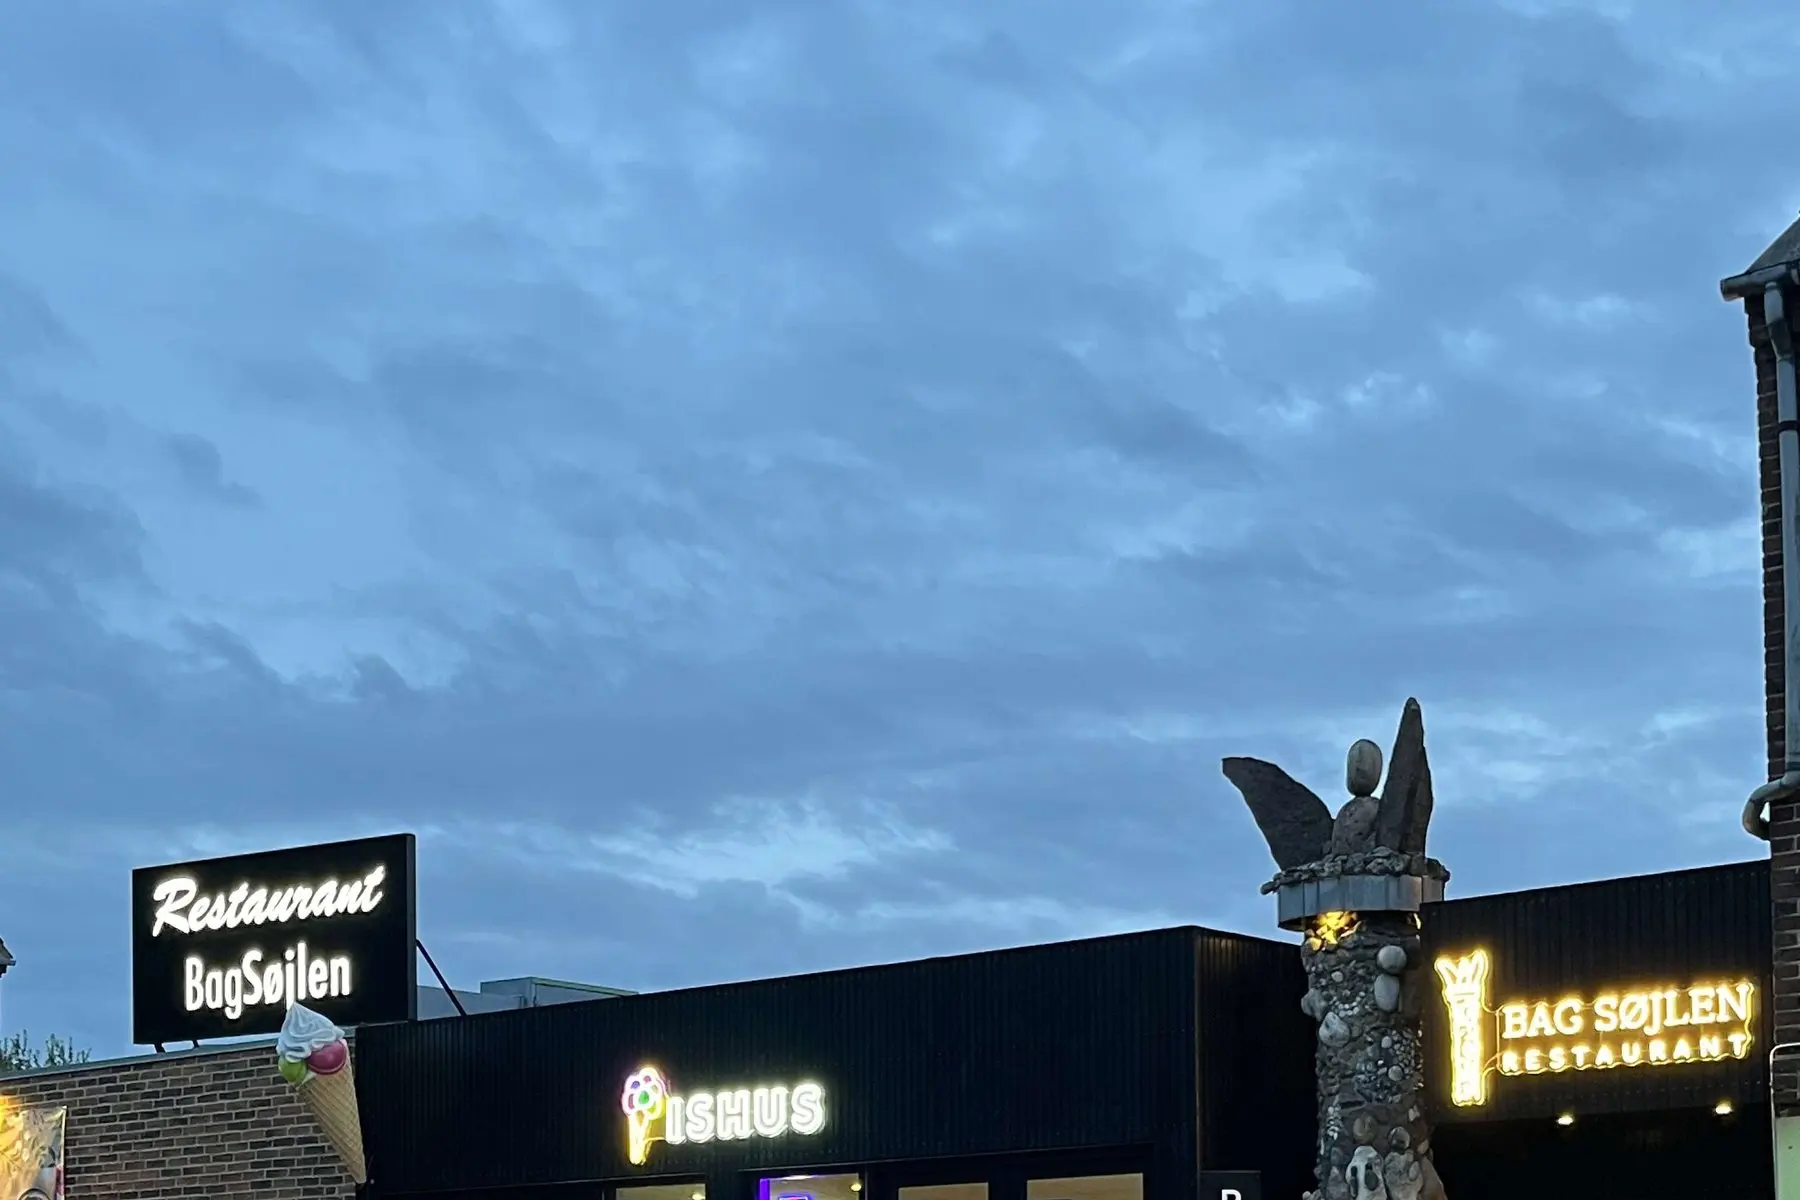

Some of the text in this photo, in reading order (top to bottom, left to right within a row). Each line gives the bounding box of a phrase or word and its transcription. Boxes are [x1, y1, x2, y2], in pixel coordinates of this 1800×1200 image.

[152, 865, 386, 937] Restaurant
[184, 941, 351, 1020] BagSøjlen
[1501, 982, 1752, 1039] BAG SØJLEN
[1501, 1034, 1747, 1072] RESTAURANT
[666, 1083, 826, 1145] ISHUS
